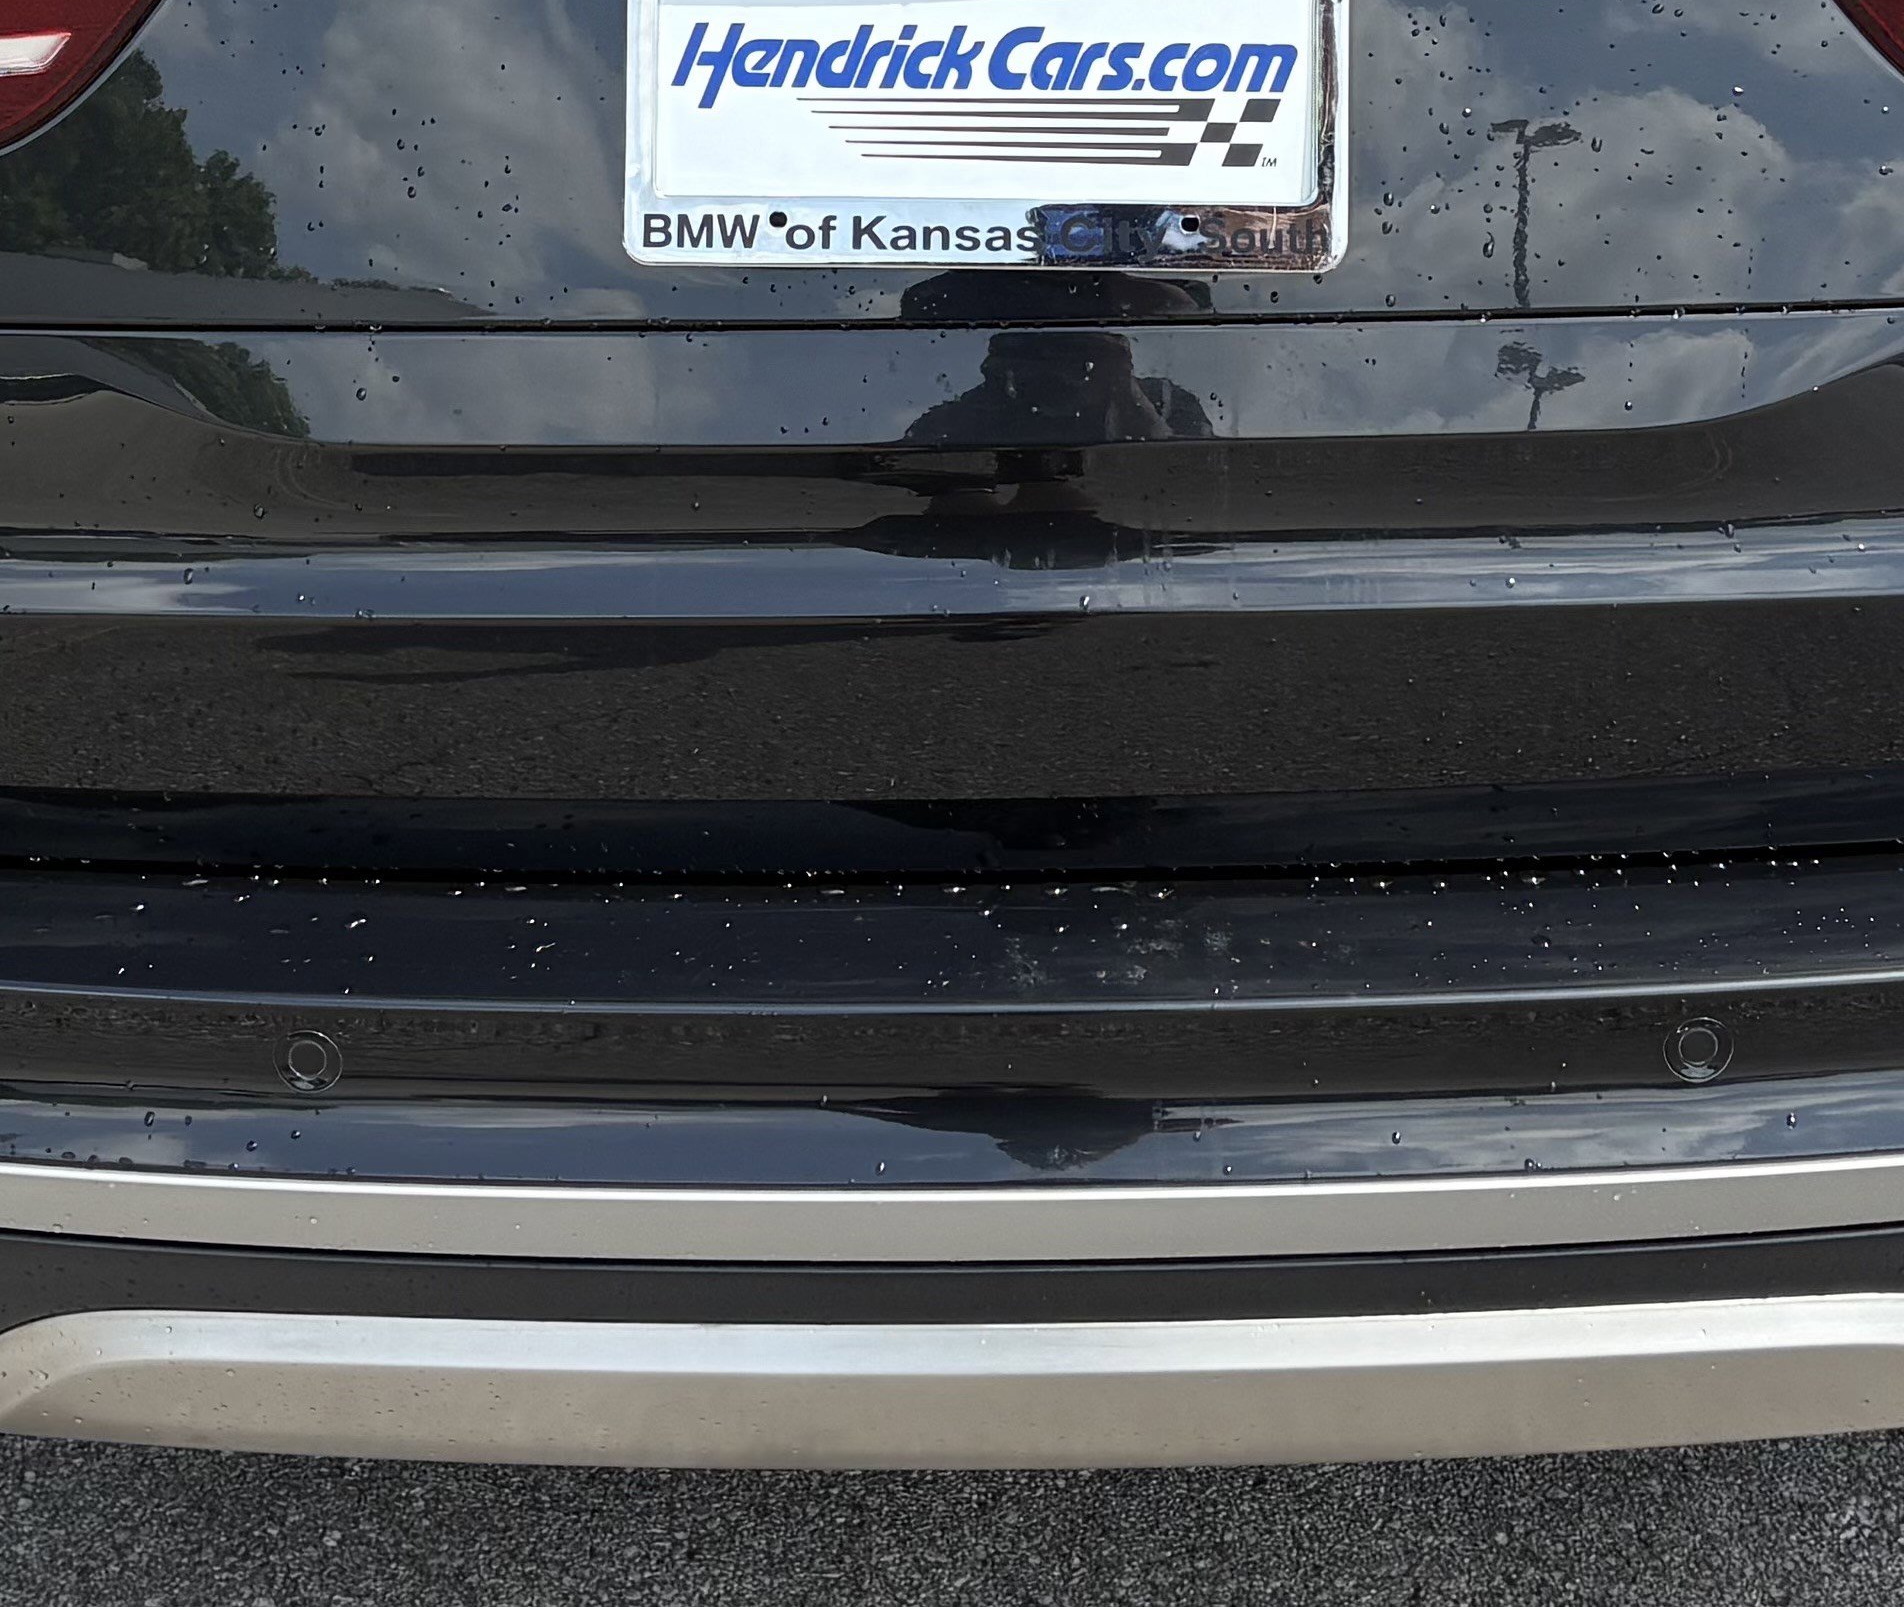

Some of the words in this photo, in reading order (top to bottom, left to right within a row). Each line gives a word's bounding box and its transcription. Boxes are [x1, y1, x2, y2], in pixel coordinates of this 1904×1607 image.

[643, 213, 760, 249] BMW
[786, 215, 838, 250] of
[852, 215, 1041, 252] Kansas
[1060, 214, 1166, 264] City
[1199, 216, 1327, 255] South
